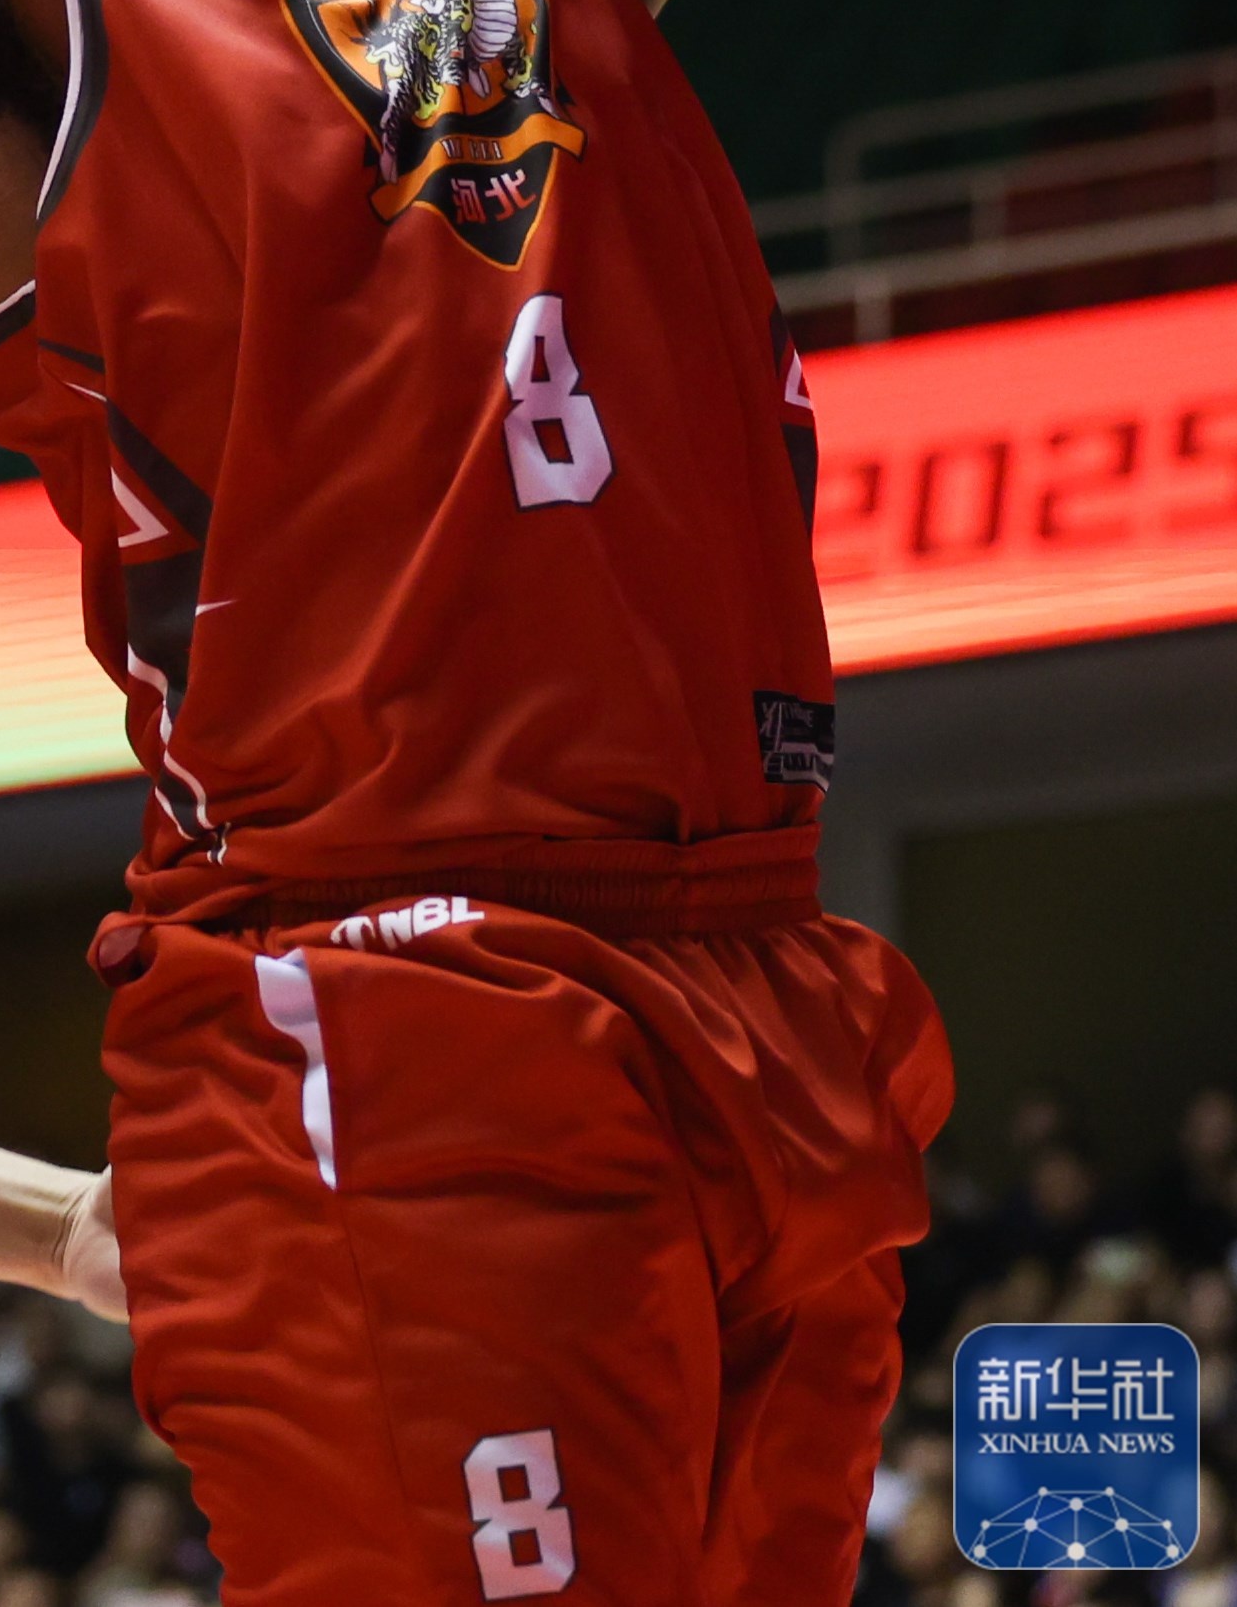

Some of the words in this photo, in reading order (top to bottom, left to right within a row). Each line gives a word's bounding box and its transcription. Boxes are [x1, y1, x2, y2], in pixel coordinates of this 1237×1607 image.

[503, 291, 617, 511] 8
[378, 896, 486, 952] NBL
[463, 1427, 577, 1602] 8
